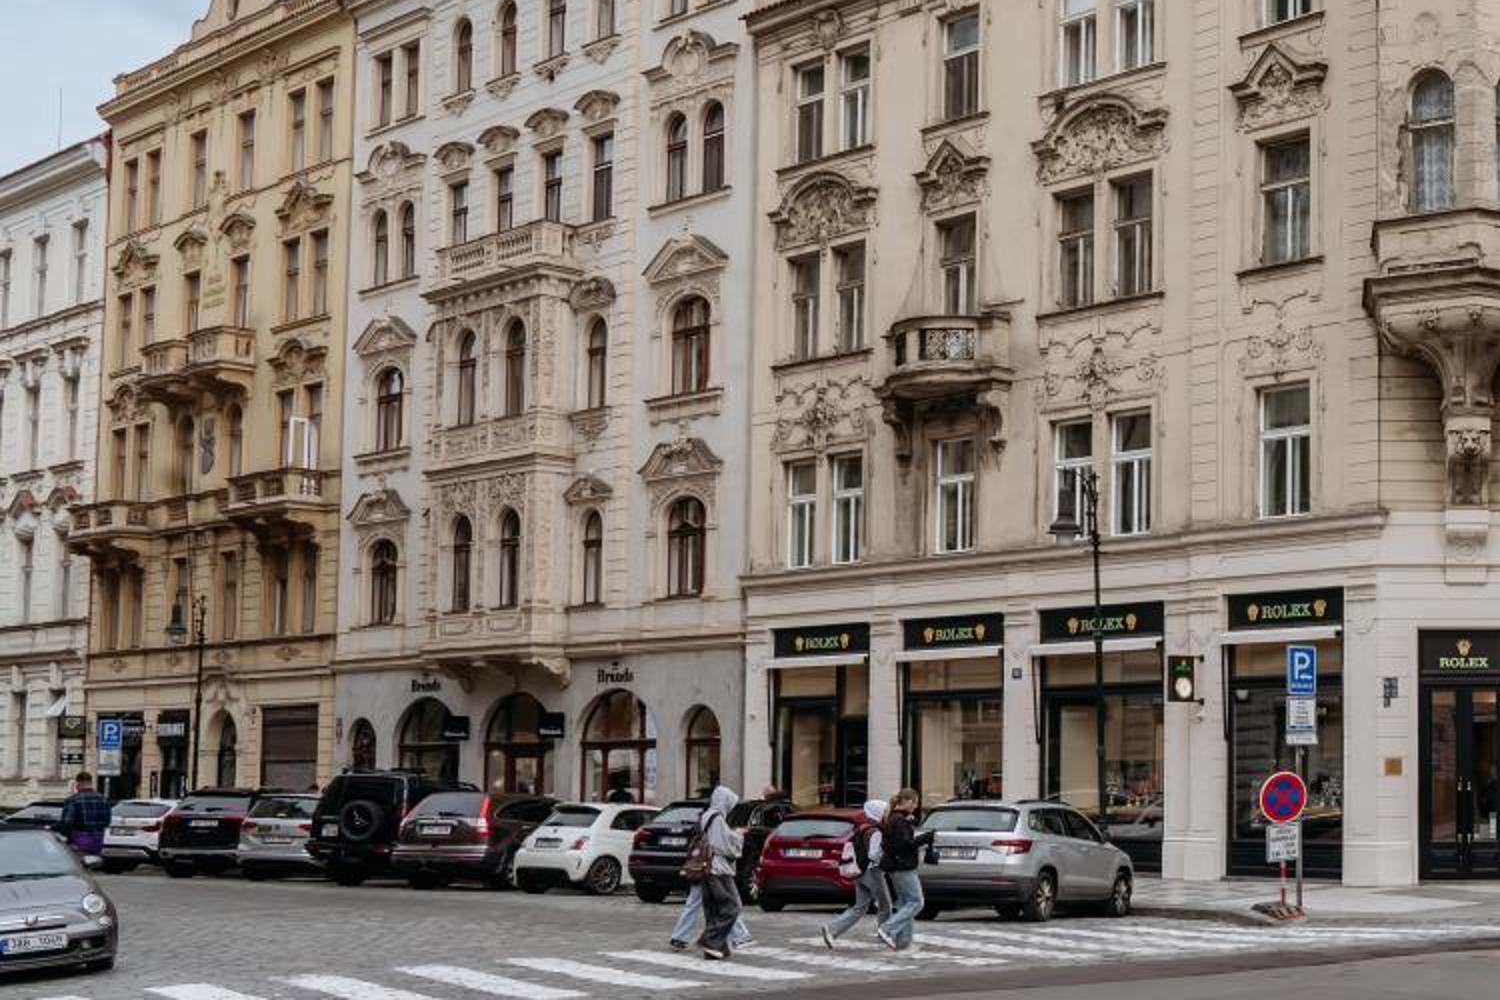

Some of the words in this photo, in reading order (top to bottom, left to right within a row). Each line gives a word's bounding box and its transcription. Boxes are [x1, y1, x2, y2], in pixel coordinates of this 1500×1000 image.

[1260, 603, 1312, 619] ROLEX
[935, 627, 974, 641] ROLEX
[805, 635, 839, 650] ROLEX
[1293, 650, 1312, 681] P
[1439, 656, 1489, 669] ROLEX
[103, 723, 118, 740] P
